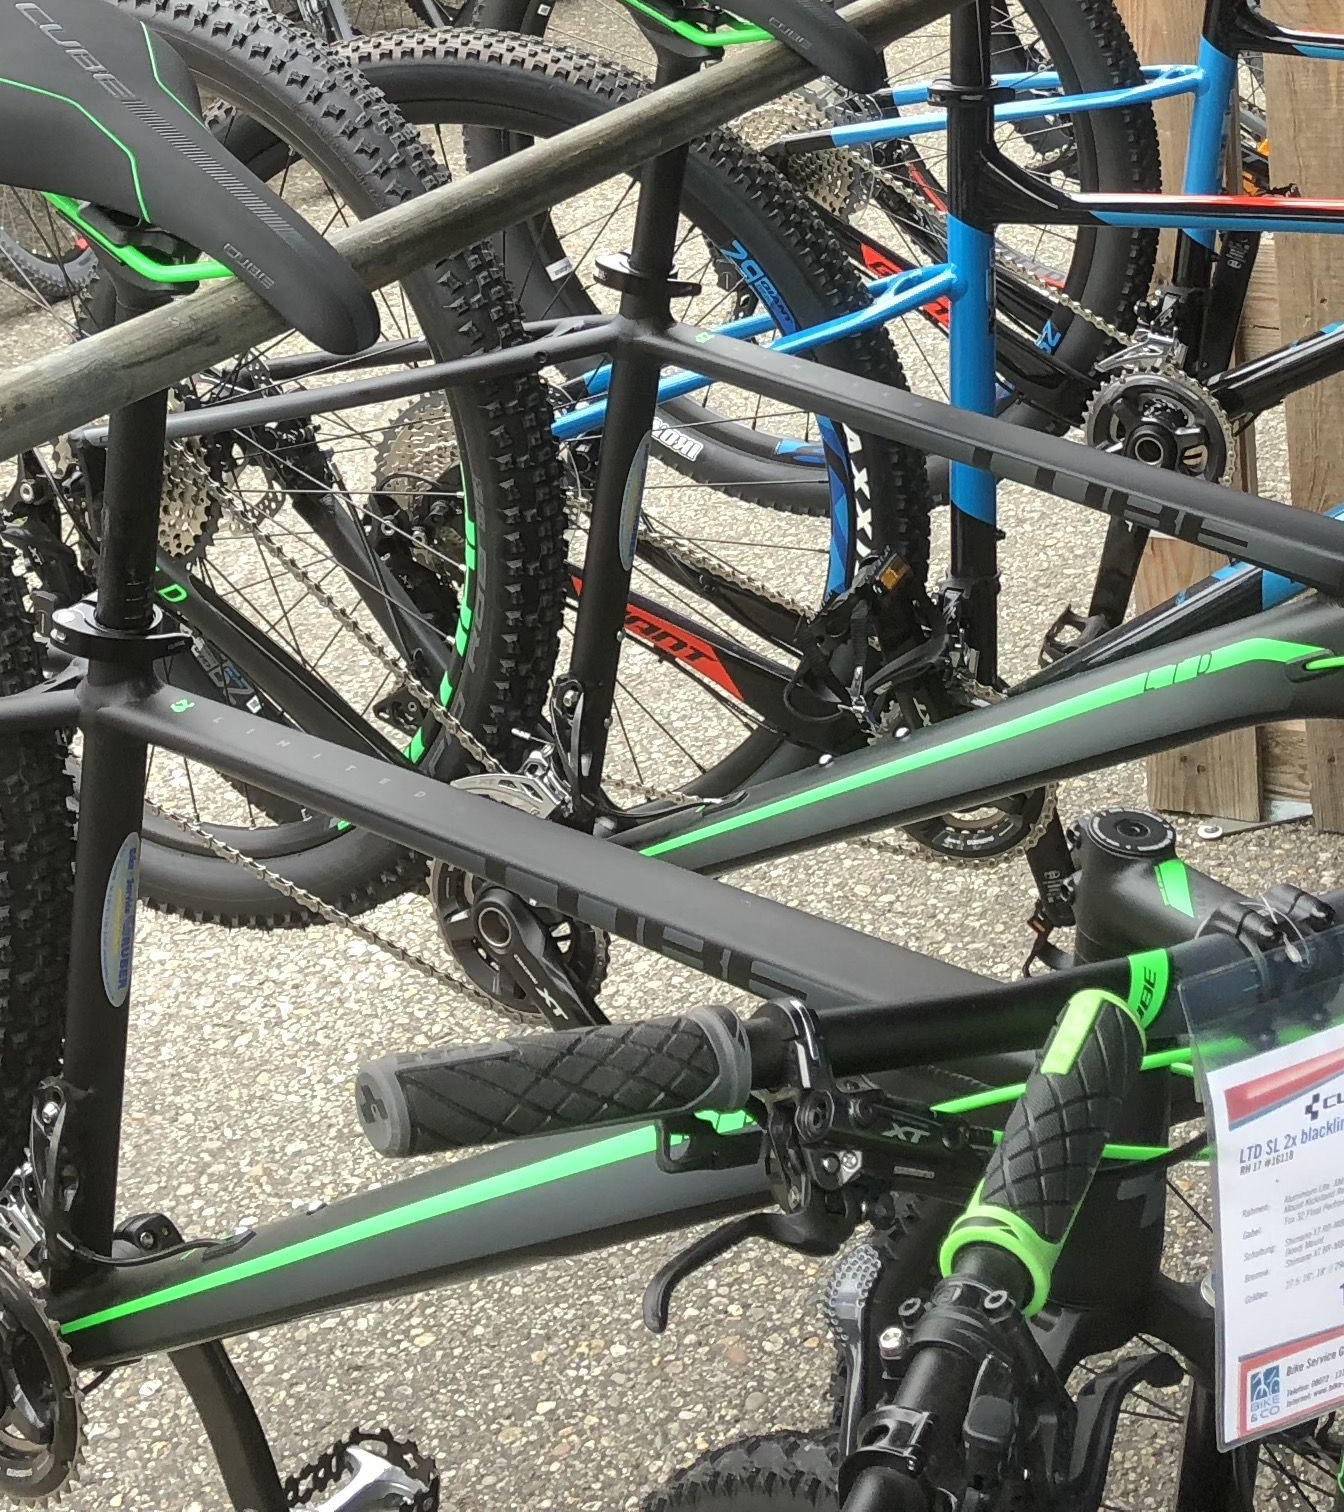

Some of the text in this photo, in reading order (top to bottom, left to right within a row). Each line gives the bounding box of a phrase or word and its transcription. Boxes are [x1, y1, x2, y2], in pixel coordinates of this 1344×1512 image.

[15, 2, 136, 100] CUBE
[223, 242, 275, 289] CUBE
[534, 986, 569, 1021] XT
[1138, 965, 1158, 1020] BE
[881, 1123, 930, 1144] XT
[1239, 1143, 1262, 1164] LTD
[1265, 1136, 1280, 1156] SL
[1283, 1133, 1298, 1151] 2x
[1239, 1162, 1252, 1176] RH
[1255, 1160, 1265, 1172] 17
[1286, 1361, 1304, 1376] Bike
[1306, 1349, 1336, 1369] Service
[1250, 1393, 1279, 1412] BIKE
[1260, 1404, 1279, 1419] CO
